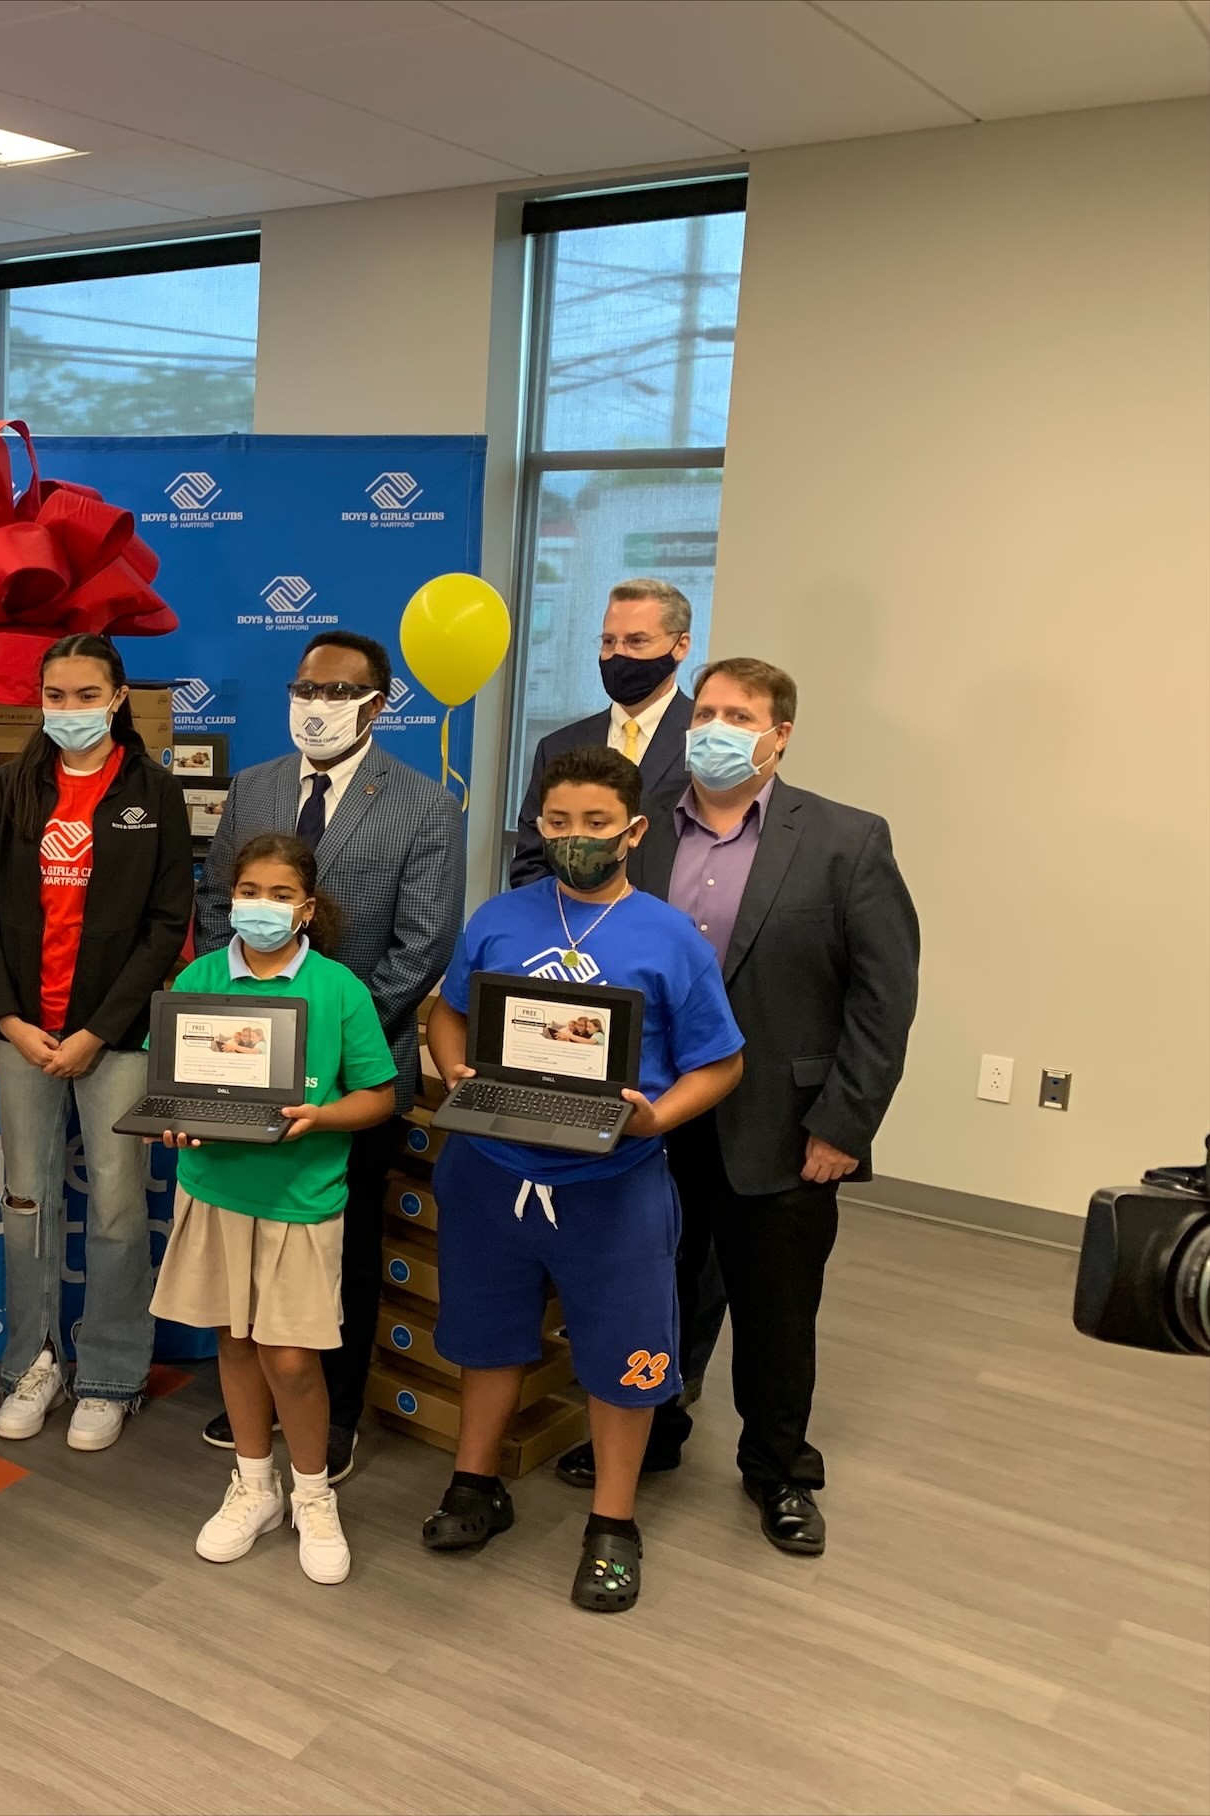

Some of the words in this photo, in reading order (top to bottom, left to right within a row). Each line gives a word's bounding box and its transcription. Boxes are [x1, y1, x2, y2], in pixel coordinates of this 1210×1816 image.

[142, 514, 166, 522] BOYS
[169, 513, 178, 522] &
[180, 513, 208, 521] GIRLS
[211, 512, 243, 521] CLUBS
[342, 513, 366, 522] BOYS
[369, 513, 378, 521] &
[380, 512, 409, 521] GIRLS
[412, 512, 444, 521] CLUBS
[237, 616, 262, 625] BOYS
[265, 616, 273, 625] &
[275, 616, 304, 624] GIRLS
[306, 615, 338, 624] CLUBS
[205, 716, 236, 724] CLUBS
[404, 716, 436, 724] CLUBS
[47, 866, 78, 877] GIRLS
[44, 877, 88, 886] HARTFORD
[620, 1349, 670, 1390] 23
